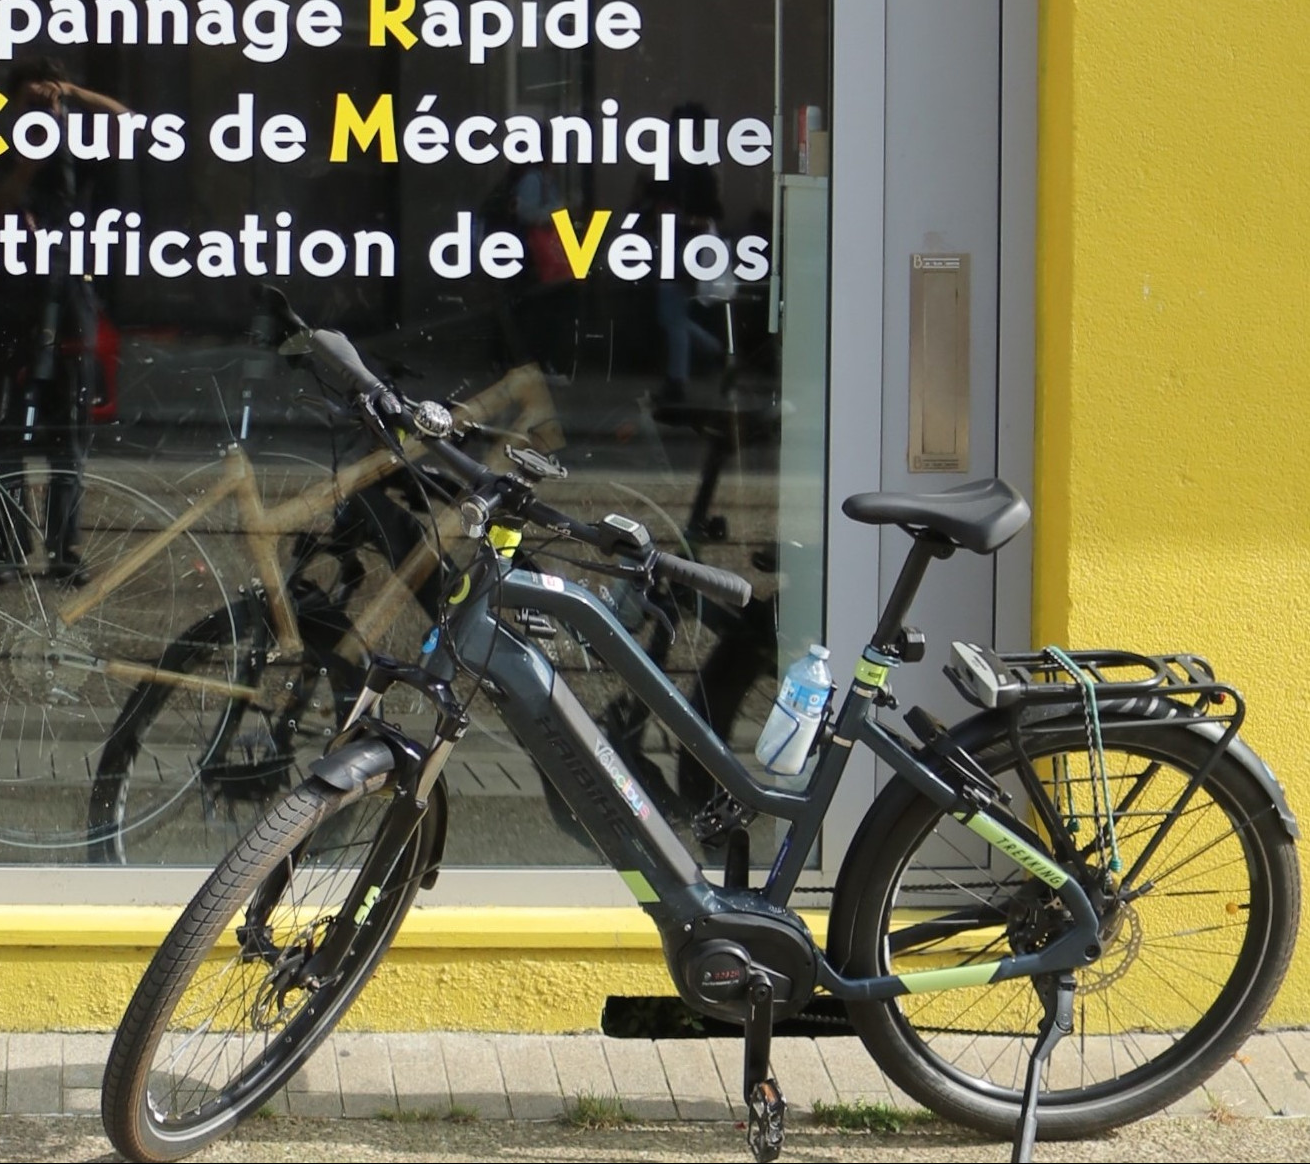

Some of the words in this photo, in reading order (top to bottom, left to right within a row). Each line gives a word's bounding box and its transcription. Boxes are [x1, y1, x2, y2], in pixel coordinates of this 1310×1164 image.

[210, 94, 305, 162] de
[331, 94, 771, 180] Mécanique
[430, 212, 523, 278] de
[552, 209, 767, 280] Vélos
[996, 836, 1064, 885] TREKKING
